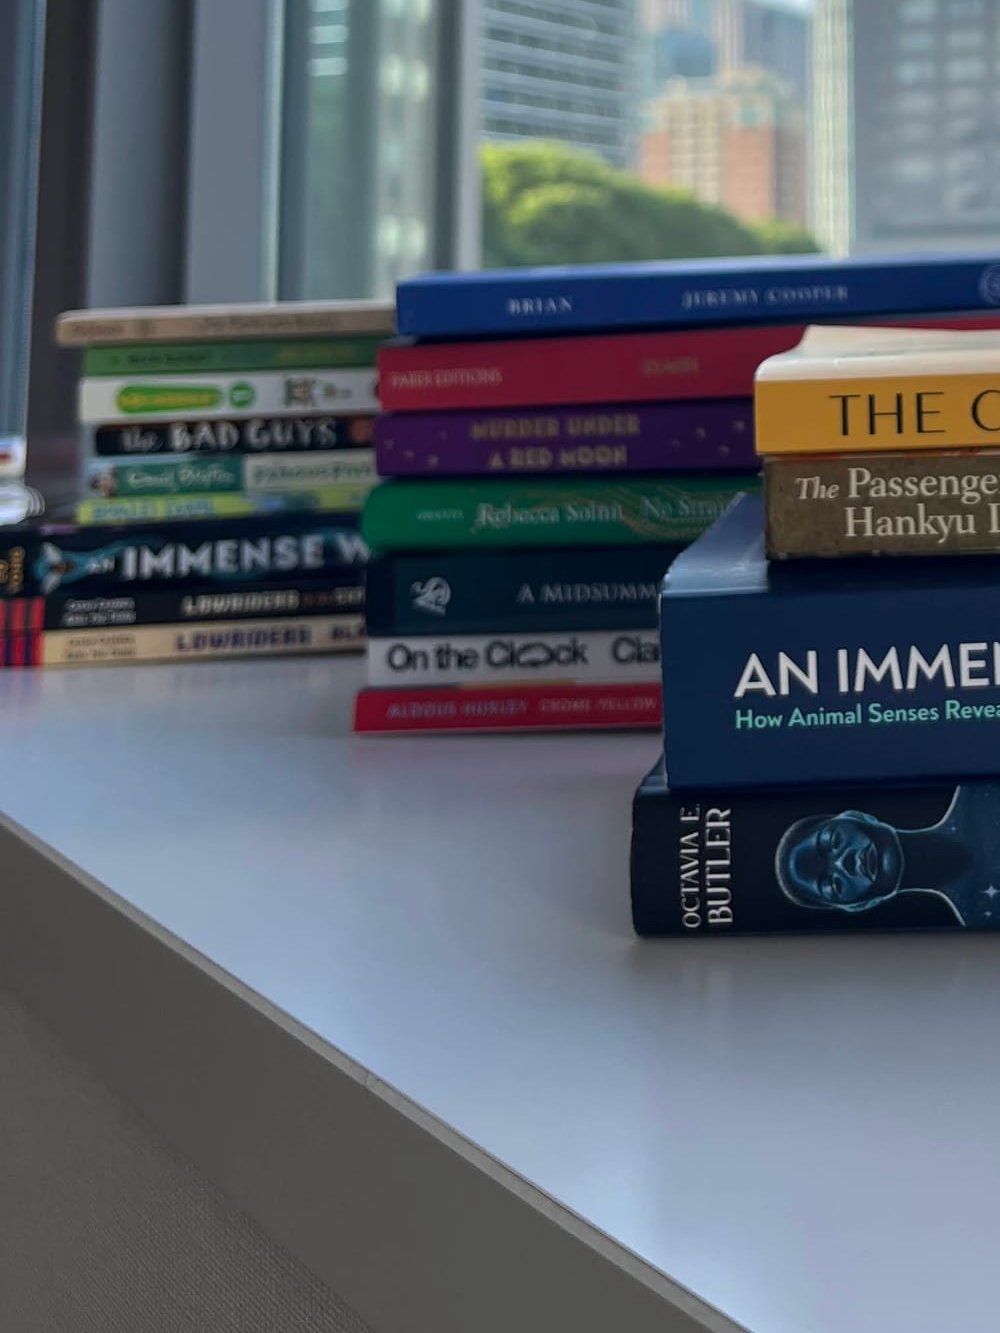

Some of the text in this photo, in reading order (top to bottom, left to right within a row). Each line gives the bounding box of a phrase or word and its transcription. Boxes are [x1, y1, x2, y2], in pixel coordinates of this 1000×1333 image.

[508, 296, 573, 315] BRIAN
[681, 283, 848, 309] JEREMY COOPER
[391, 368, 503, 390] FABER EDITIONS
[469, 413, 641, 440] MURDER UNDER
[829, 392, 946, 436] THE
[169, 421, 240, 450] BAD
[246, 416, 338, 448] GUYS
[486, 444, 627, 470] A RED MOON
[795, 475, 840, 500] The
[475, 501, 624, 528] Rebecca Solnit
[845, 503, 977, 544] Hankyu
[122, 534, 324, 580] IMMENSE
[516, 582, 535, 604] A
[386, 642, 430, 671] On
[434, 640, 479, 670] the
[733, 650, 819, 698] AN
[735, 708, 783, 730] How
[788, 702, 862, 727] Animal
[868, 702, 939, 724] Senses
[705, 807, 733, 924] BUTLER
[680, 831, 702, 929] OCTAVIA
